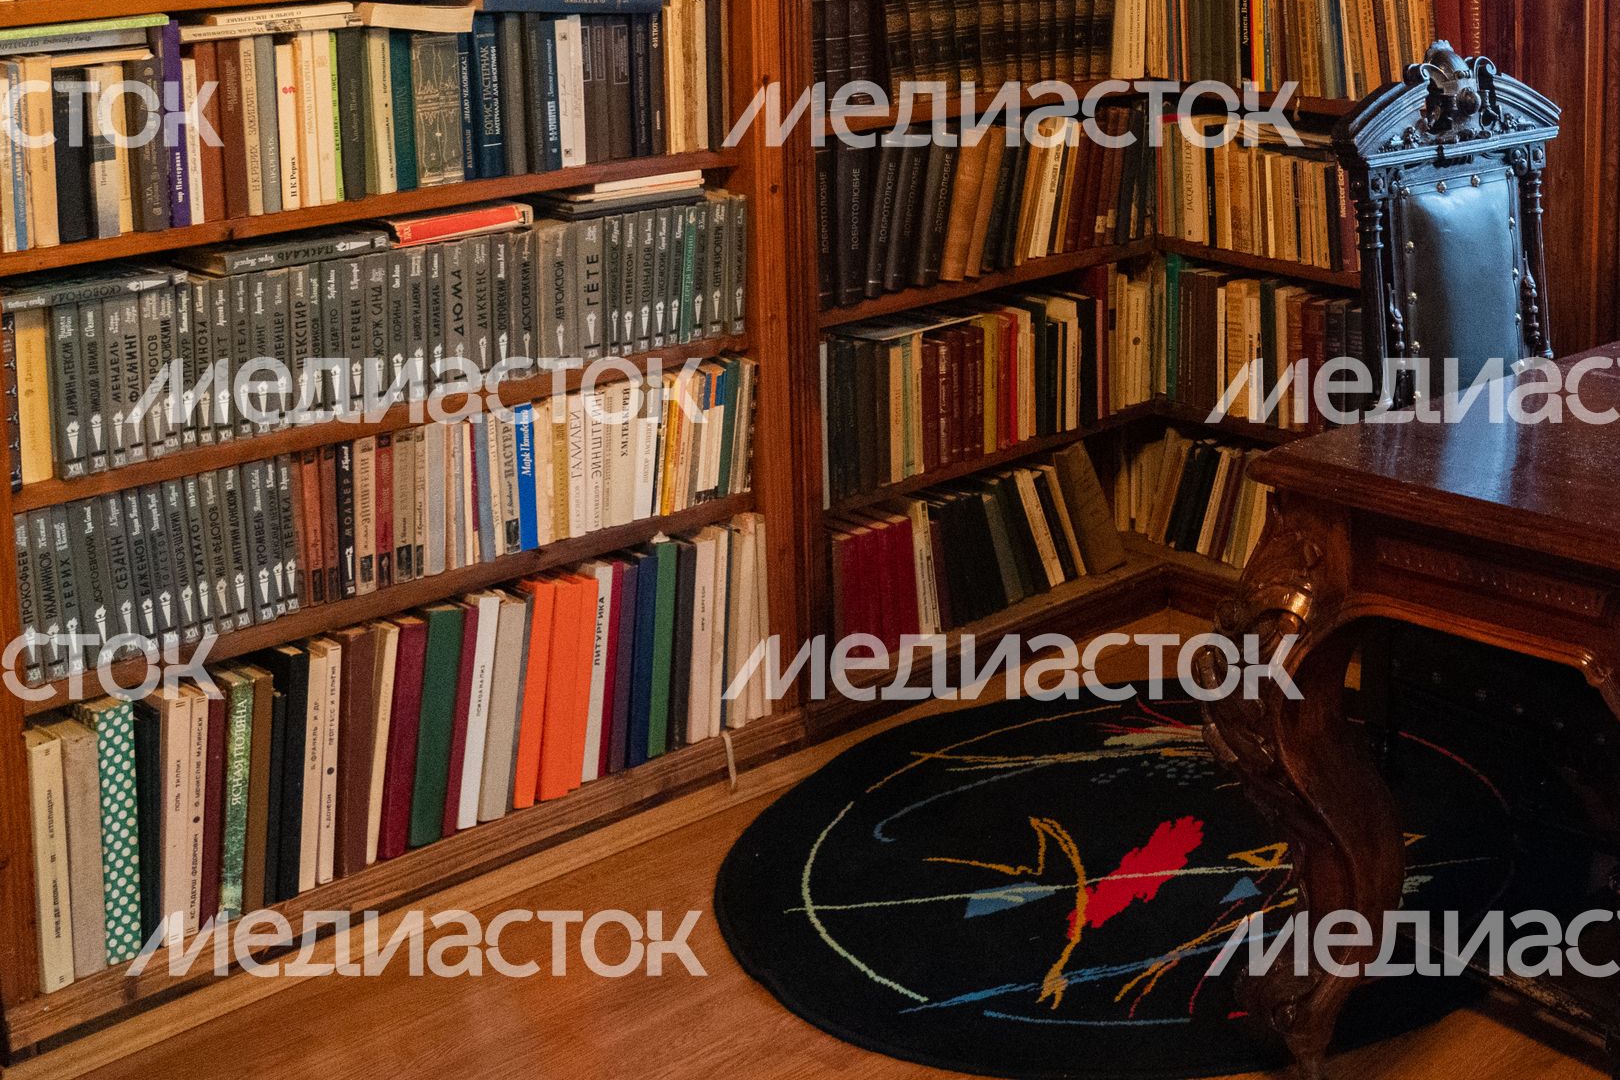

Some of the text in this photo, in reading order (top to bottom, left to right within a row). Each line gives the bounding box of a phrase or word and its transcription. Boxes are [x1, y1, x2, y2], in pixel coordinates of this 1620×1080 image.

[480, 46, 494, 136] БОРИС ПАСТЕРНАК
[851, 168, 860, 250] ДОБРОТОЛЮБИЕ
[879, 162, 896, 243] ДОБРОТОЛЮБИЕ
[935, 153, 952, 232] ДОБРОТОЛЮБИЕ
[1186, 174, 1194, 212] JACQUES
[1339, 187, 1347, 218] Meister
[276, 245, 334, 262] ПАСКАЛЬ
[584, 254, 599, 306] ГЁТЕ
[642, 247, 653, 303] ГОНЧАРОВ
[352, 299, 361, 349] ГЕРЦЕН
[451, 269, 464, 336] ДЮМА
[477, 270, 488, 329] ДИККЕНС
[521, 260, 532, 331] ДОСТОЕВСКИЙ
[295, 301, 307, 369] ШЕКСПИР
[372, 319, 384, 357] ЖОРЖ
[110, 341, 121, 403] МЕНДЕЛЬ
[125, 334, 139, 403] ФЛЕМИНГ
[520, 452, 532, 477] Марк
[283, 496, 293, 548] ПЕРИКЛ
[344, 478, 353, 536] МОЛЬЕР
[111, 535, 128, 589] СЕЗАНН
[134, 538, 150, 596] БАЖЕНОВ
[192, 517, 205, 576] КАТАЛОГ
[254, 512, 266, 566] КРОМВЕЛЬ
[17, 551, 34, 625] ПРОКОФЬЕВ
[39, 551, 58, 619] РАХМАНИНОВ
[60, 556, 75, 608] РЕРИХ
[593, 596, 606, 666] ЛИТУРГИКА
[476, 664, 486, 717] ПСИХОАНАЛИЗ
[231, 698, 248, 806] ЯСНАЯ ПОЛЯНА
